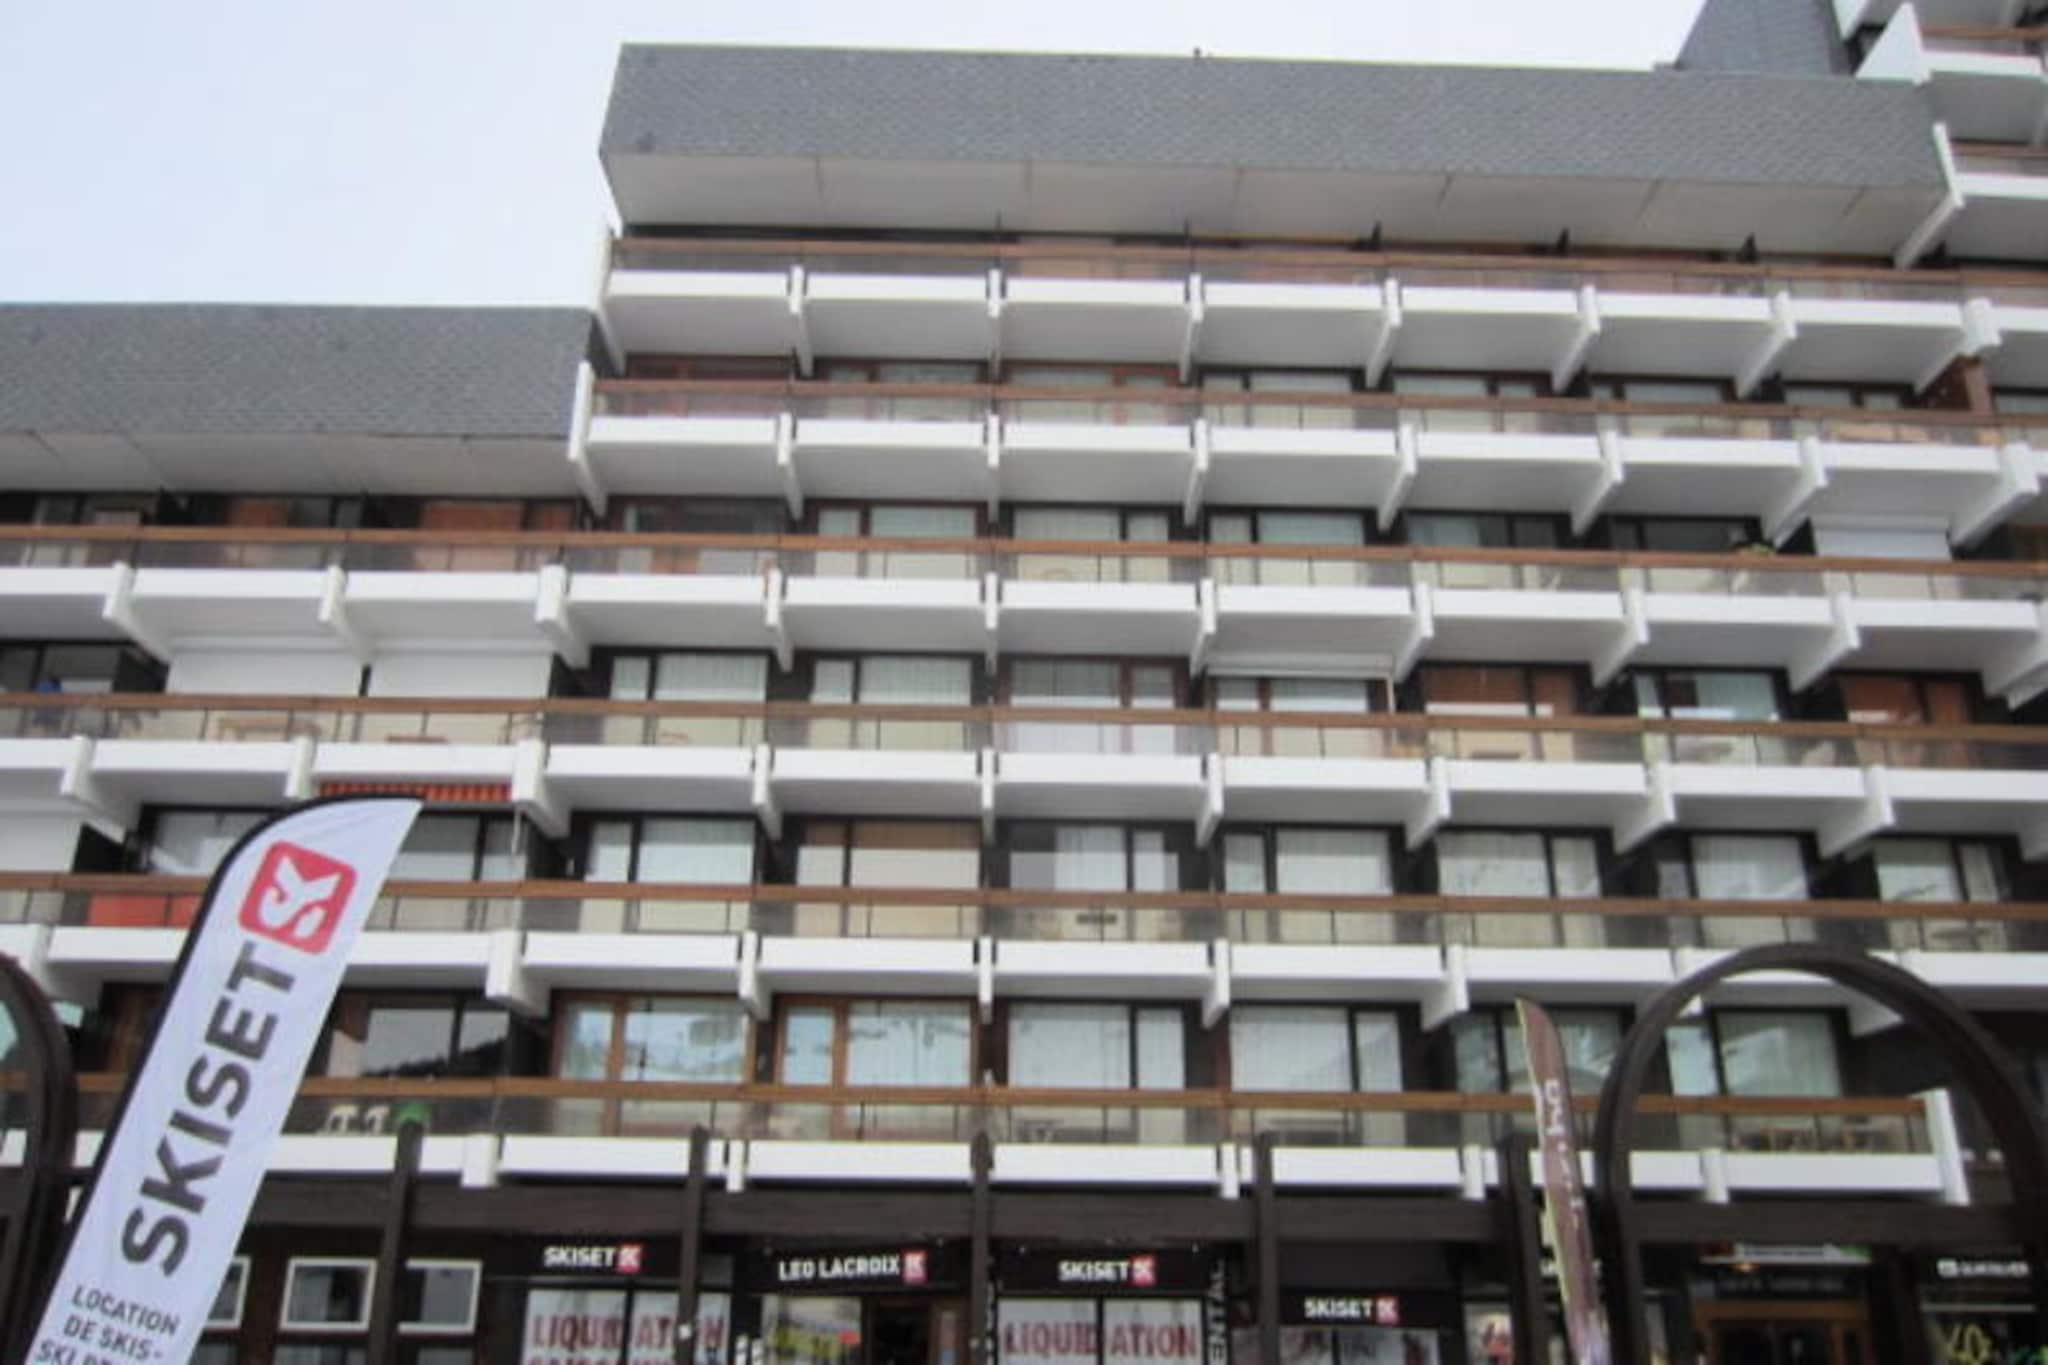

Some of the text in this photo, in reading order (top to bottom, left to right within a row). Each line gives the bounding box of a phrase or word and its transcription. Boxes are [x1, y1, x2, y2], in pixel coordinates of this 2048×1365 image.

[120, 941, 298, 1277] SKISET
[543, 1246, 616, 1268] SKISET
[778, 1253, 900, 1281] LEO LACROIX
[1058, 1259, 1130, 1282] SKISET
[71, 1284, 181, 1337] LOCATION
[1303, 1296, 1373, 1319] SKISET
[63, 1313, 97, 1342] DE
